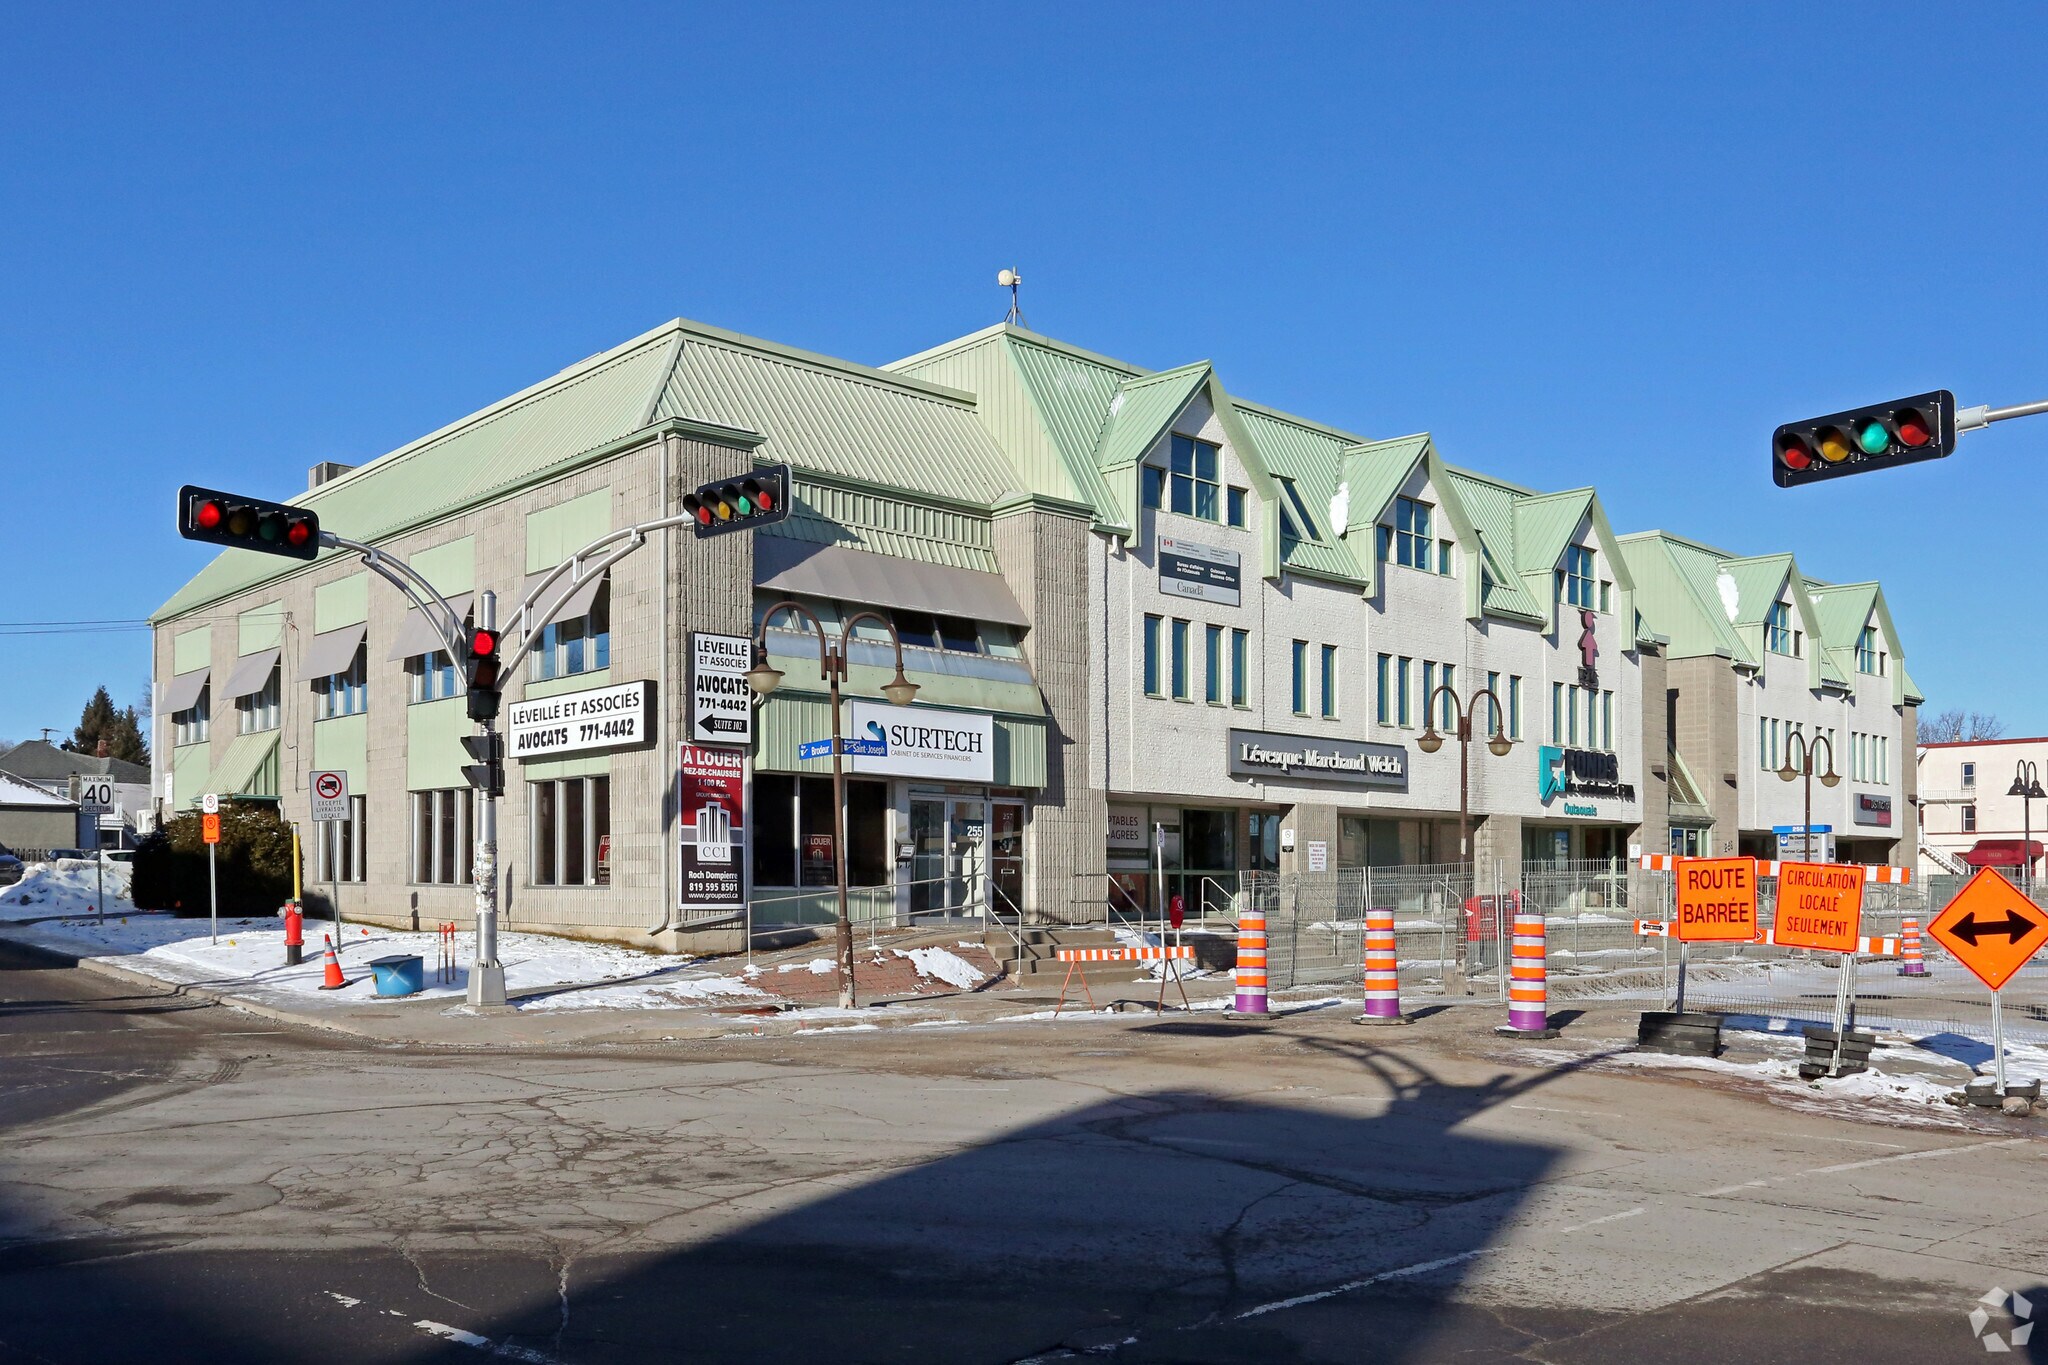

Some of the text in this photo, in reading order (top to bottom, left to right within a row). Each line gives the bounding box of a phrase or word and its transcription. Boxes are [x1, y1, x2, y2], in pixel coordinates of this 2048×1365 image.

[1177, 581, 1204, 596] Canada
[698, 637, 748, 657] LÉVEILLÉ
[700, 656, 747, 669] ET ASSOCIÉS
[696, 674, 749, 696] AVOCATS
[514, 688, 640, 725] LÉVEILLÉ ET ASSOCIÉS
[699, 696, 747, 712] 771-4442
[518, 718, 634, 750] AVOCATS 771-4442
[714, 720, 742, 730] SUITE 102
[891, 724, 983, 753] SURTECH
[683, 746, 741, 768] À LOUER
[811, 746, 830, 756] Brodeur
[853, 744, 885, 756] Saint-Joseph
[890, 750, 912, 758] CABINET
[920, 752, 943, 760] SERVICES
[944, 754, 972, 762] FINANCIERS
[1241, 742, 1402, 774] Lévesque Marchand Welch
[684, 767, 740, 778] REZ-DE-CHAUSSÉE
[1565, 749, 1618, 785] FONDS
[84, 784, 110, 804] 40
[967, 826, 982, 837] 255
[810, 838, 830, 846] LOUER
[702, 846, 726, 858] CCI
[688, 870, 738, 880] Roch Dompierre
[1688, 868, 1745, 890] ROUTE
[1787, 870, 1856, 890] CIRCULATION
[689, 882, 738, 891] 819 595 8501
[1684, 898, 1749, 924] BARRÉE
[1800, 894, 1838, 912] LOCALE
[1786, 917, 1848, 936] SEULEMENT
